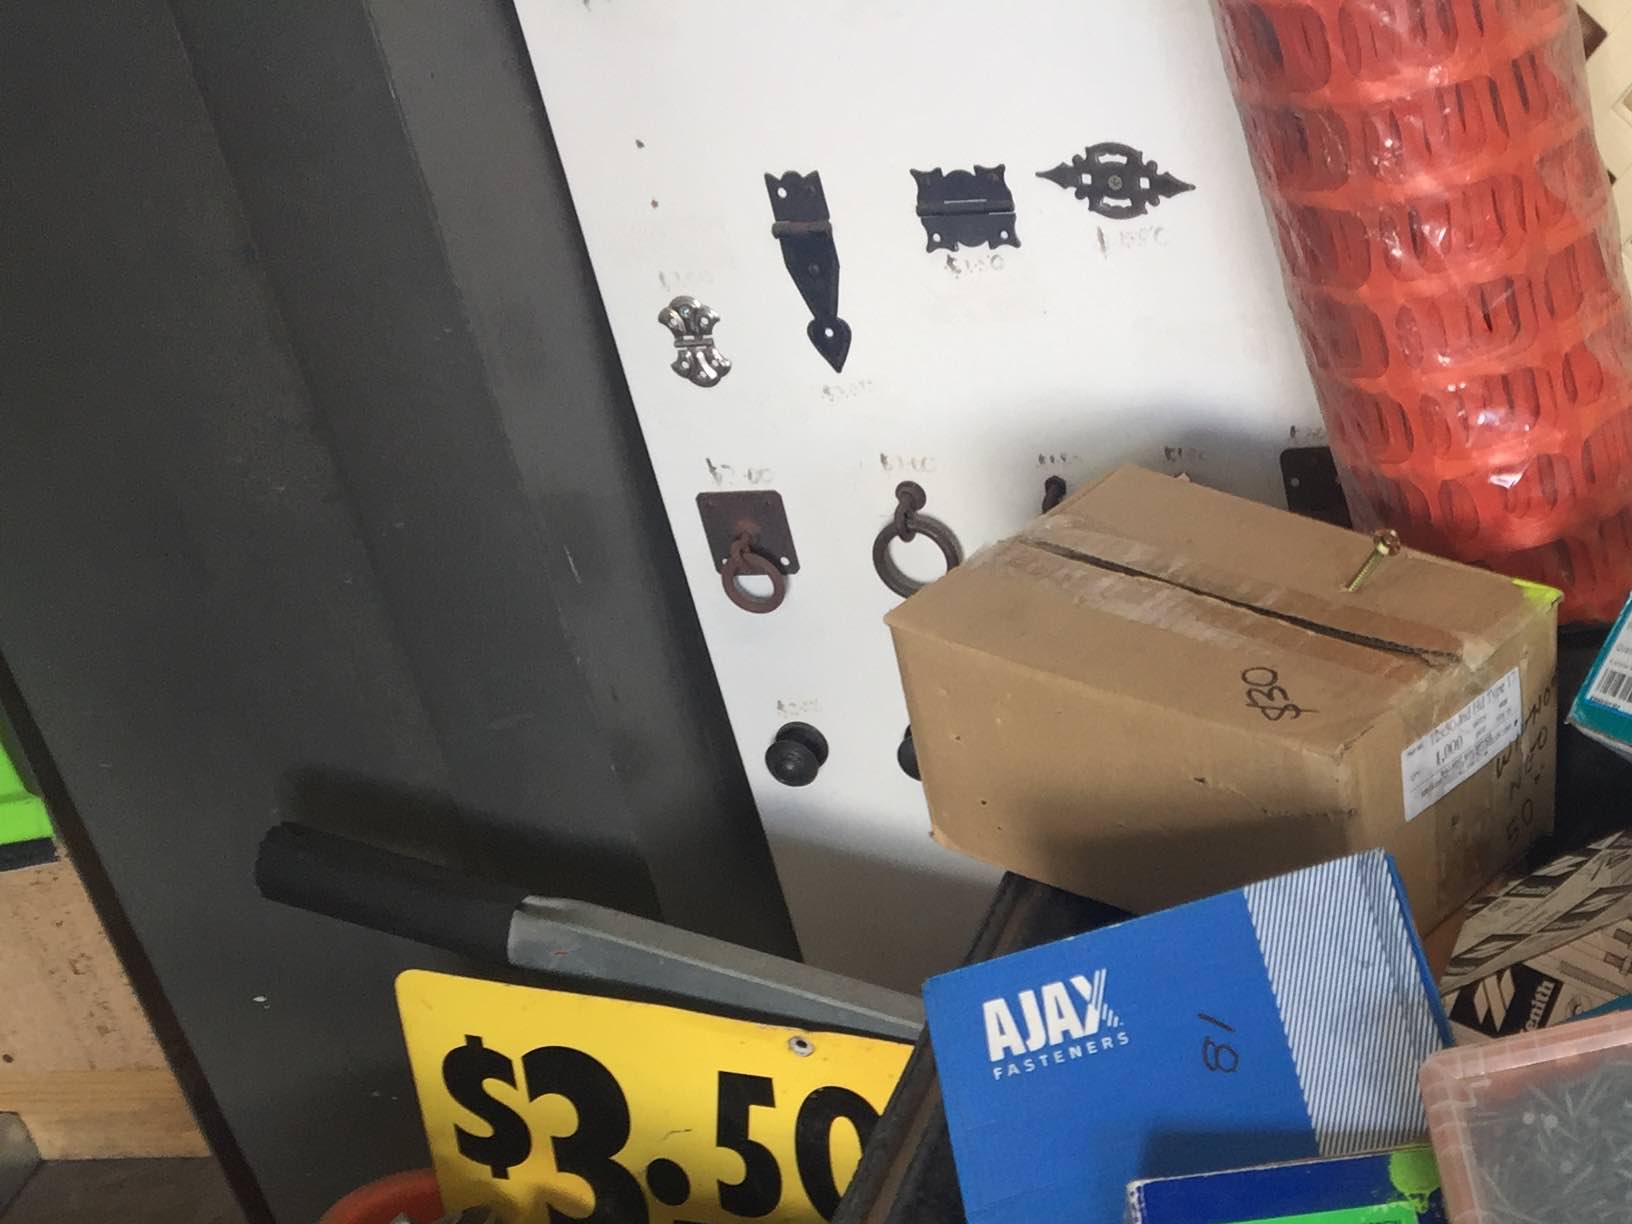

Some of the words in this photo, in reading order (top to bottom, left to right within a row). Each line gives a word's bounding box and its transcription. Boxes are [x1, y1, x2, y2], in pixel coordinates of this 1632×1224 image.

[981, 967, 1120, 1063] AJAX
[1520, 978, 1556, 1034] enith
[992, 1031, 1131, 1081] FASTENERS
